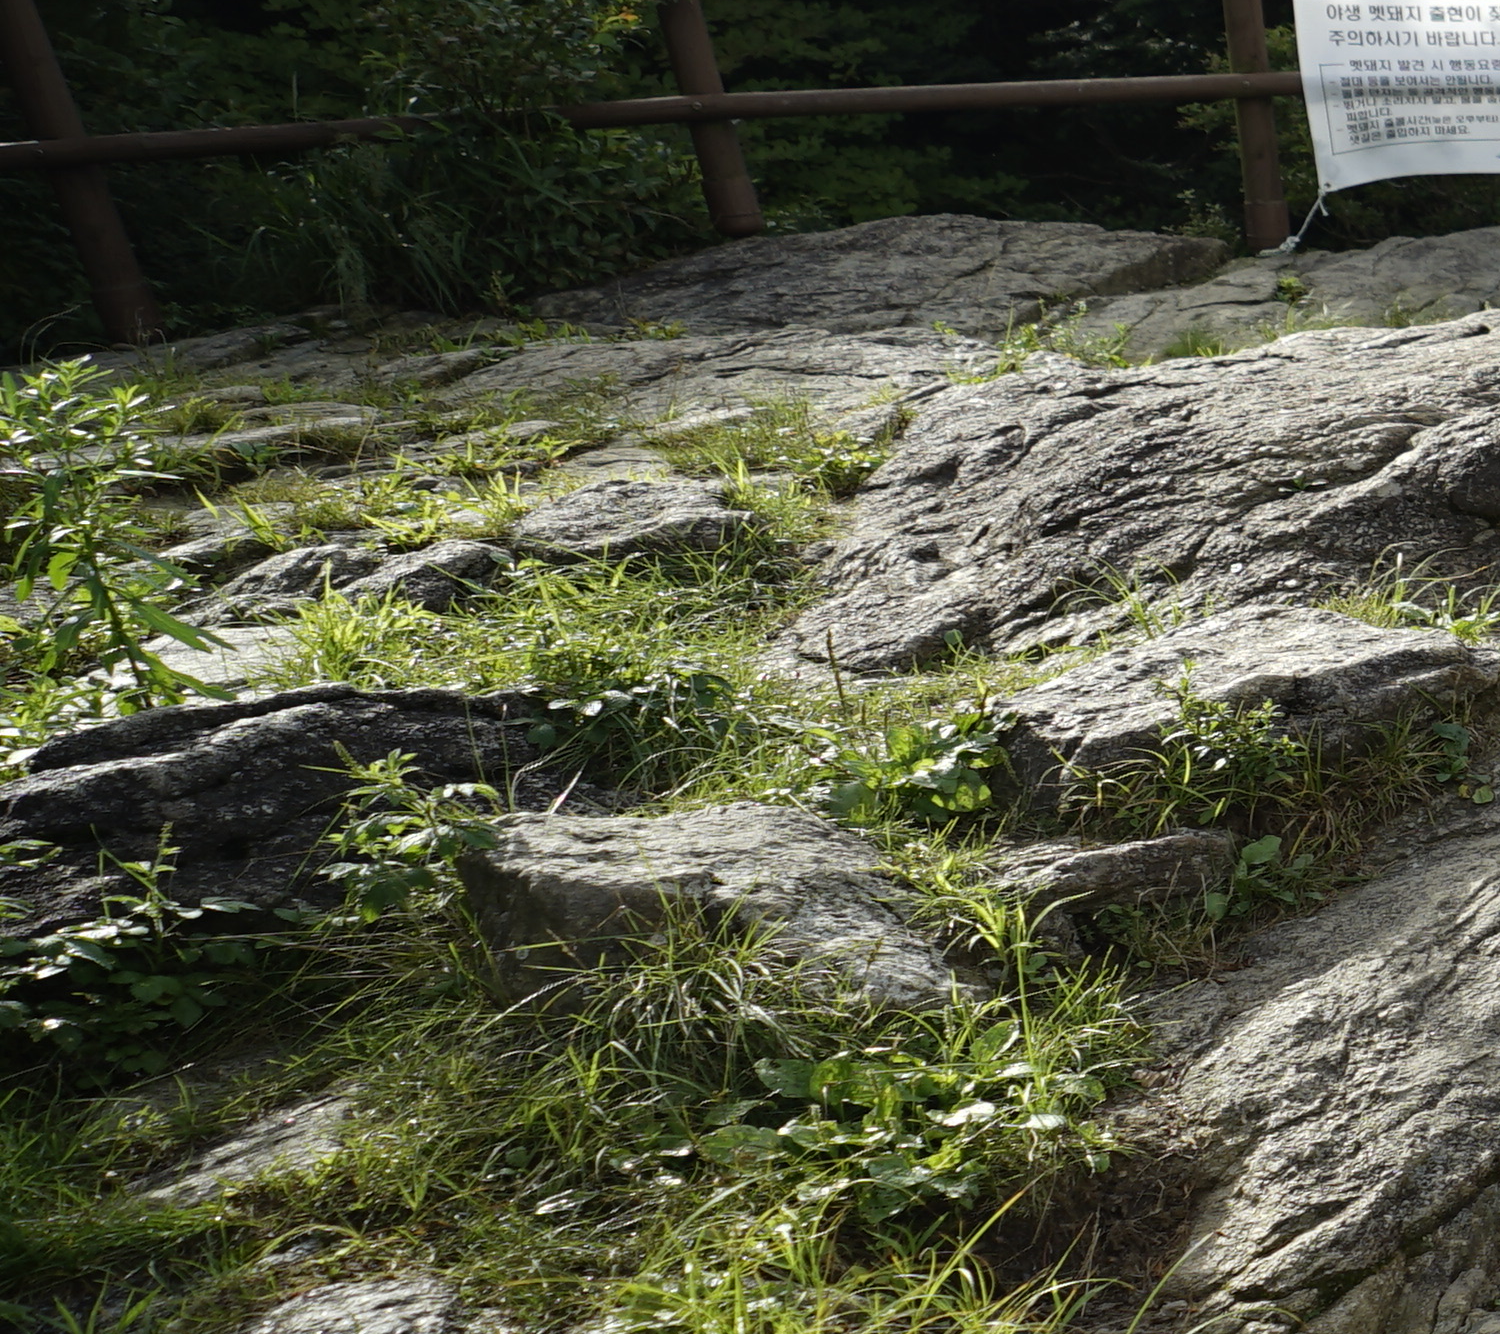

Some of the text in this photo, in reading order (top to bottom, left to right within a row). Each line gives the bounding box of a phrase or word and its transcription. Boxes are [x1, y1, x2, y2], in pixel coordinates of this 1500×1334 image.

[1326, 4, 1361, 21] 야생
[1368, 5, 1421, 22] 멧돼지
[1429, 5, 1481, 22] 출현이
[1329, 30, 1500, 46] 주의하시기 바랍니다.
[1349, 59, 1392, 71] 멧돼지
[1397, 59, 1425, 71] 발견
[1431, 59, 1444, 71] 시
